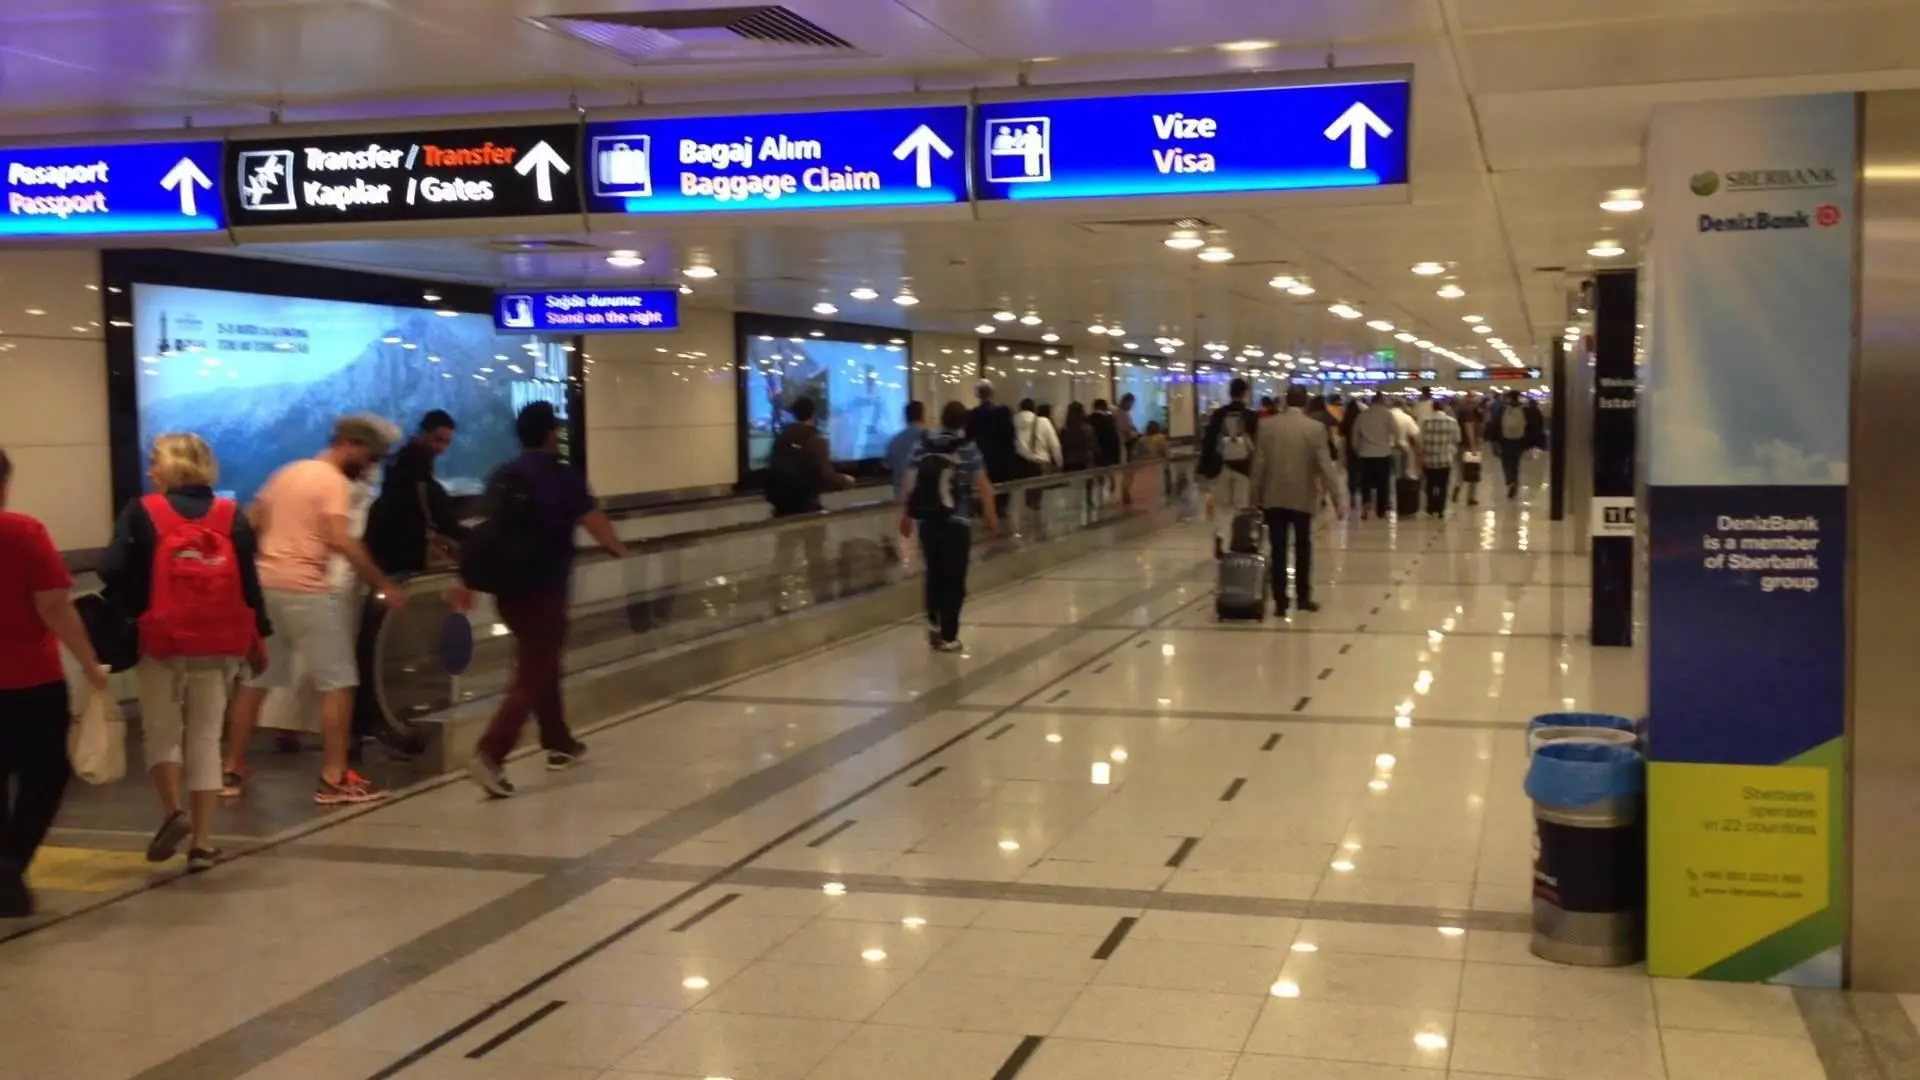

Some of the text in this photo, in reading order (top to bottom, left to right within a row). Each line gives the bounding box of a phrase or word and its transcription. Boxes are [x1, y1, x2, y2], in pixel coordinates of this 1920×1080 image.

[1152, 112, 1217, 140] Vize
[304, 144, 403, 171] Transfer
[422, 142, 515, 166] Transfer
[679, 134, 821, 169] Bagaj Alım
[1152, 147, 1216, 174] Visa
[8, 160, 109, 189] Pasaport
[680, 166, 880, 201] Baggage Claim
[1726, 168, 1839, 186] SBERBANK
[8, 190, 109, 219] Passport
[1698, 211, 1809, 232] DenizBank
[1717, 515, 1819, 531] DenizBank
[1703, 534, 1819, 550] is a member
[1704, 554, 1819, 570] of Sberbank
[1760, 576, 1819, 592] group
